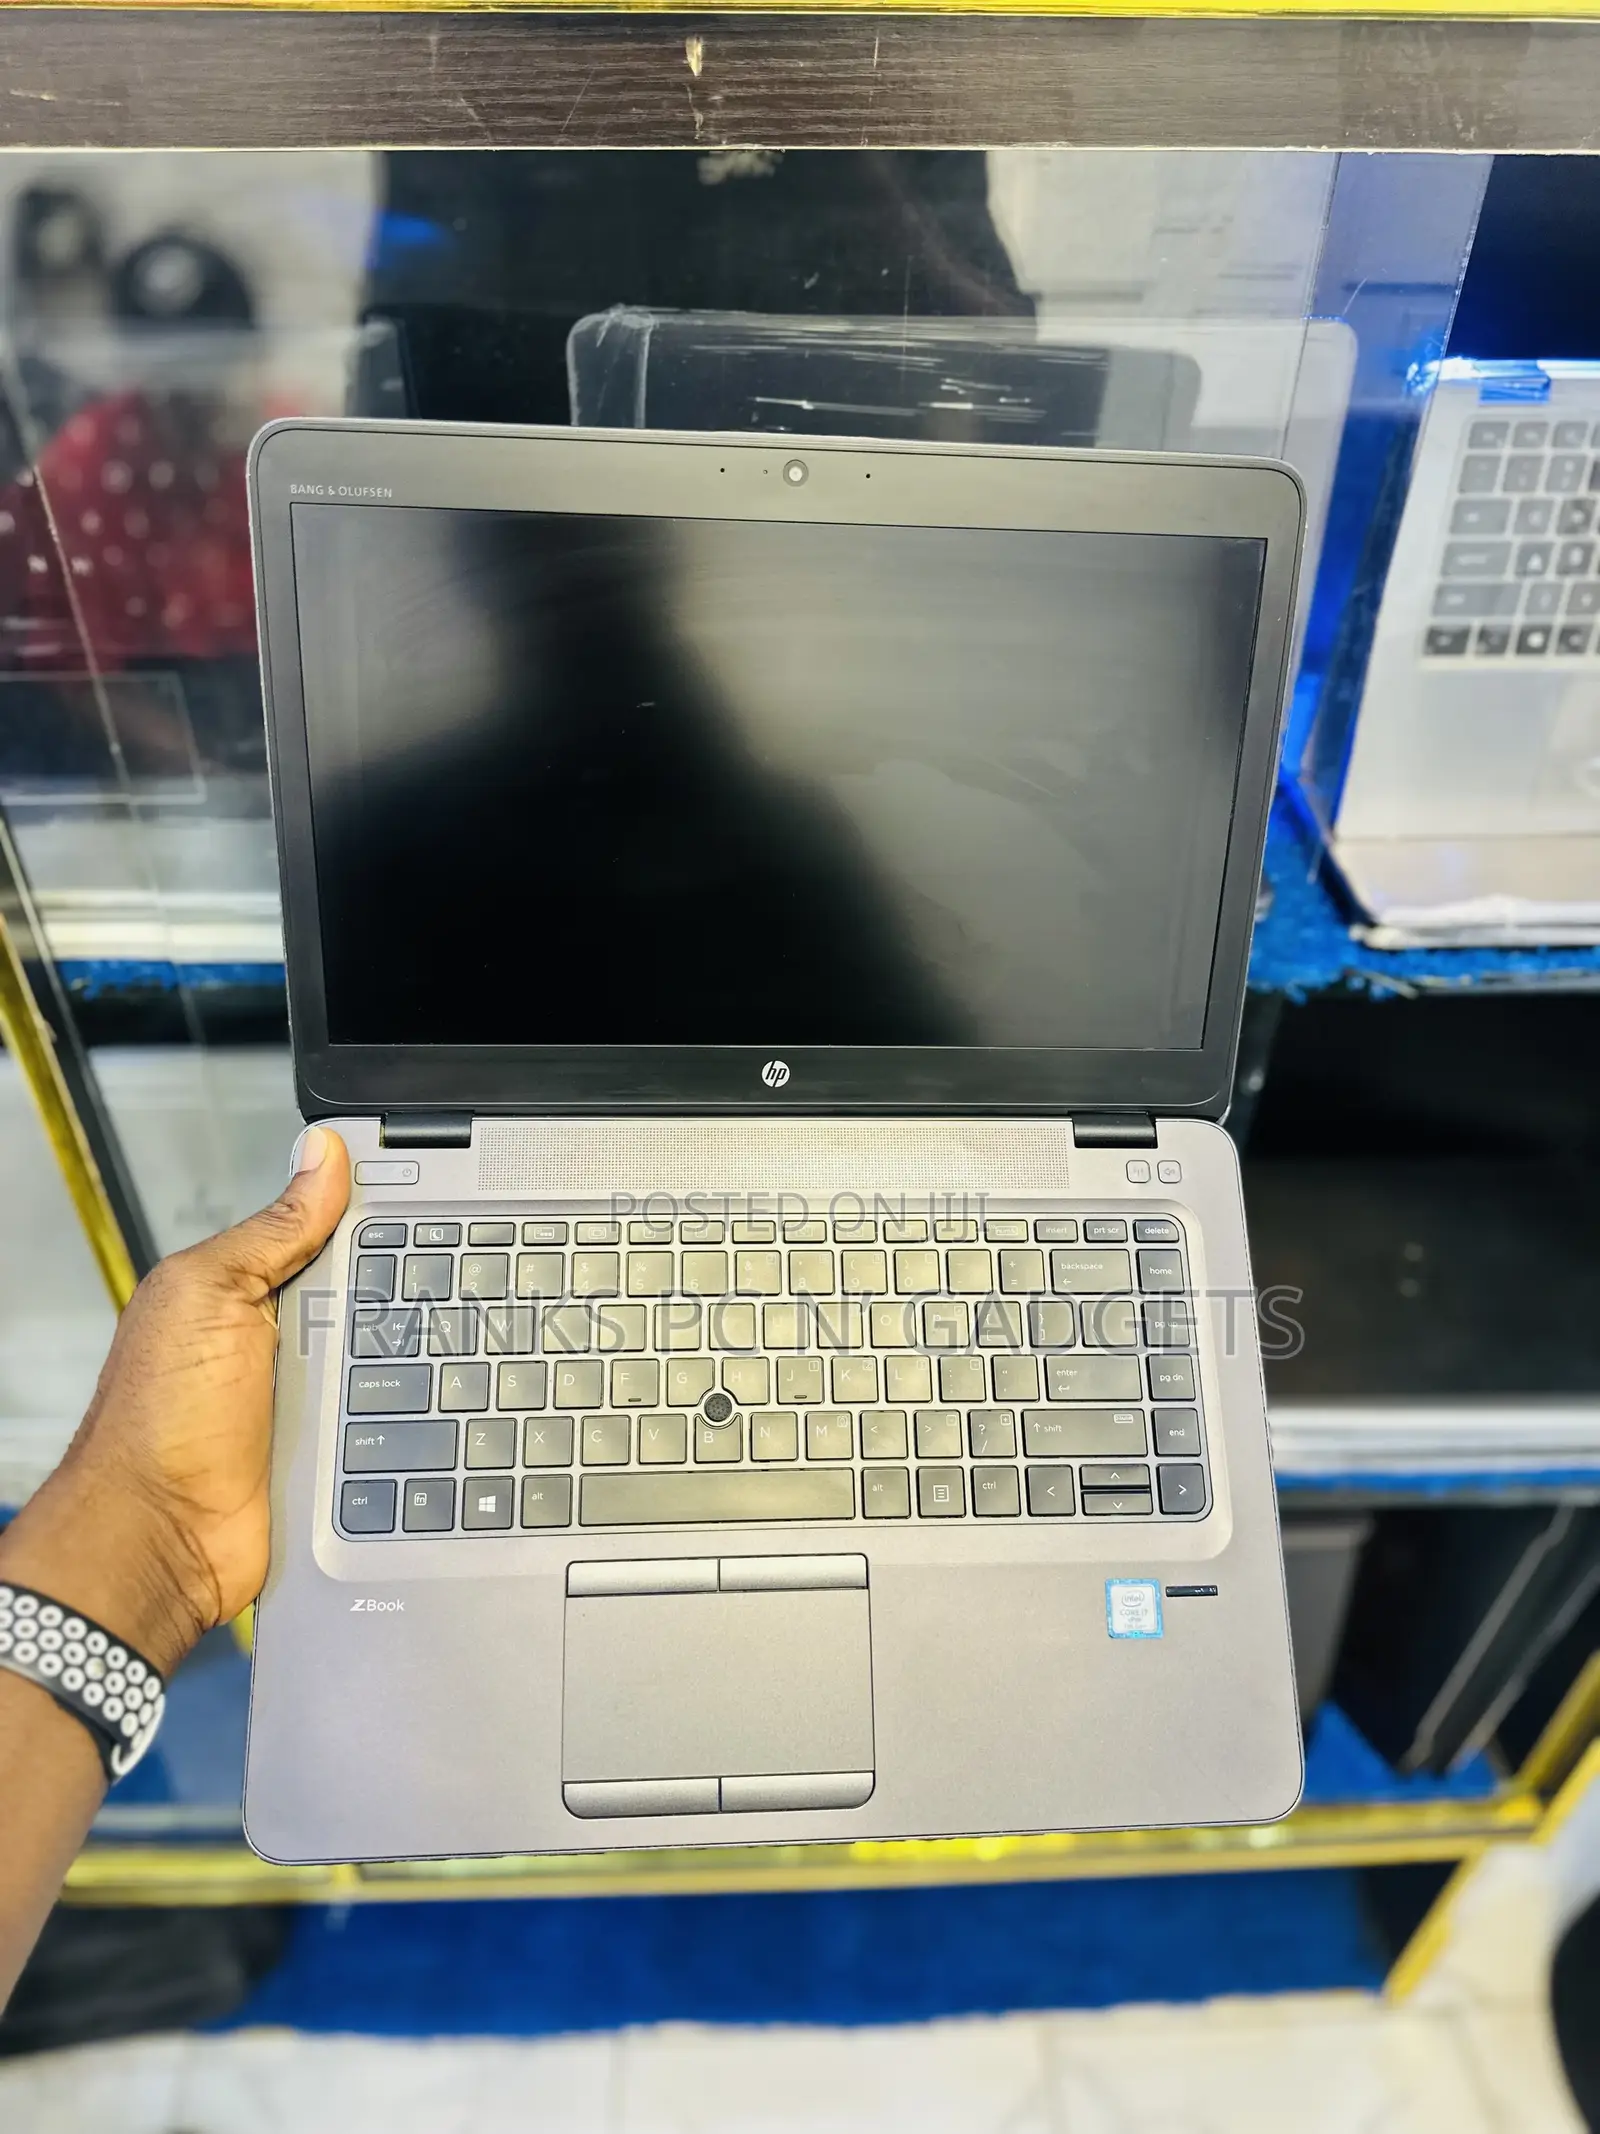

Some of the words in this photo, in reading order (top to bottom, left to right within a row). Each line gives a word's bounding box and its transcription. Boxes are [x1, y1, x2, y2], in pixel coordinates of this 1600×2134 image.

[290, 484, 324, 495] BANG
[328, 486, 335, 495] &
[338, 486, 392, 498] OLUFSEN
[763, 1060, 789, 1088] hp
[368, 1231, 384, 1239] esc
[1045, 1226, 1067, 1234] insert
[1093, 1226, 1105, 1235] prt
[1145, 1226, 1169, 1234] delete
[469, 1263, 482, 1276] @
[525, 1263, 535, 1274] #
[1061, 1262, 1103, 1271] backspace
[1150, 1267, 1173, 1275] home
[469, 1282, 478, 1292] 2
[526, 1281, 534, 1292] 3
[635, 1280, 644, 1290] 5
[690, 1279, 699, 1290] 6
[798, 1277, 806, 1288] 8
[850, 1277, 859, 1288] 9
[439, 1320, 451, 1332] Q
[676, 1372, 688, 1384] G
[731, 1371, 742, 1383] H
[786, 1370, 794, 1382] J
[841, 1369, 852, 1381] K
[894, 1369, 903, 1380] L
[1056, 1368, 1078, 1377] enter
[1160, 1374, 1171, 1382] pg
[1172, 1373, 1184, 1381] dn
[358, 1379, 380, 1389] caps
[382, 1379, 401, 1388] lock
[450, 1376, 462, 1388] A
[507, 1375, 517, 1387] S
[564, 1374, 575, 1386] D
[620, 1373, 630, 1385] F
[760, 1427, 770, 1439] N
[816, 1425, 828, 1437] M
[978, 1424, 986, 1435] ?
[1043, 1423, 1062, 1433] shift
[1169, 1428, 1185, 1437] end
[475, 1433, 486, 1446] Z
[534, 1431, 545, 1444] X
[591, 1430, 603, 1442] C
[648, 1429, 660, 1441] V
[704, 1431, 714, 1443] B
[355, 1436, 375, 1446] shift
[872, 1484, 884, 1492] alt
[982, 1481, 997, 1490] ctrl
[352, 1496, 368, 1506] ctrl
[416, 1494, 425, 1503] fn
[532, 1491, 543, 1501] alt
[349, 1599, 405, 1611] ZBook
